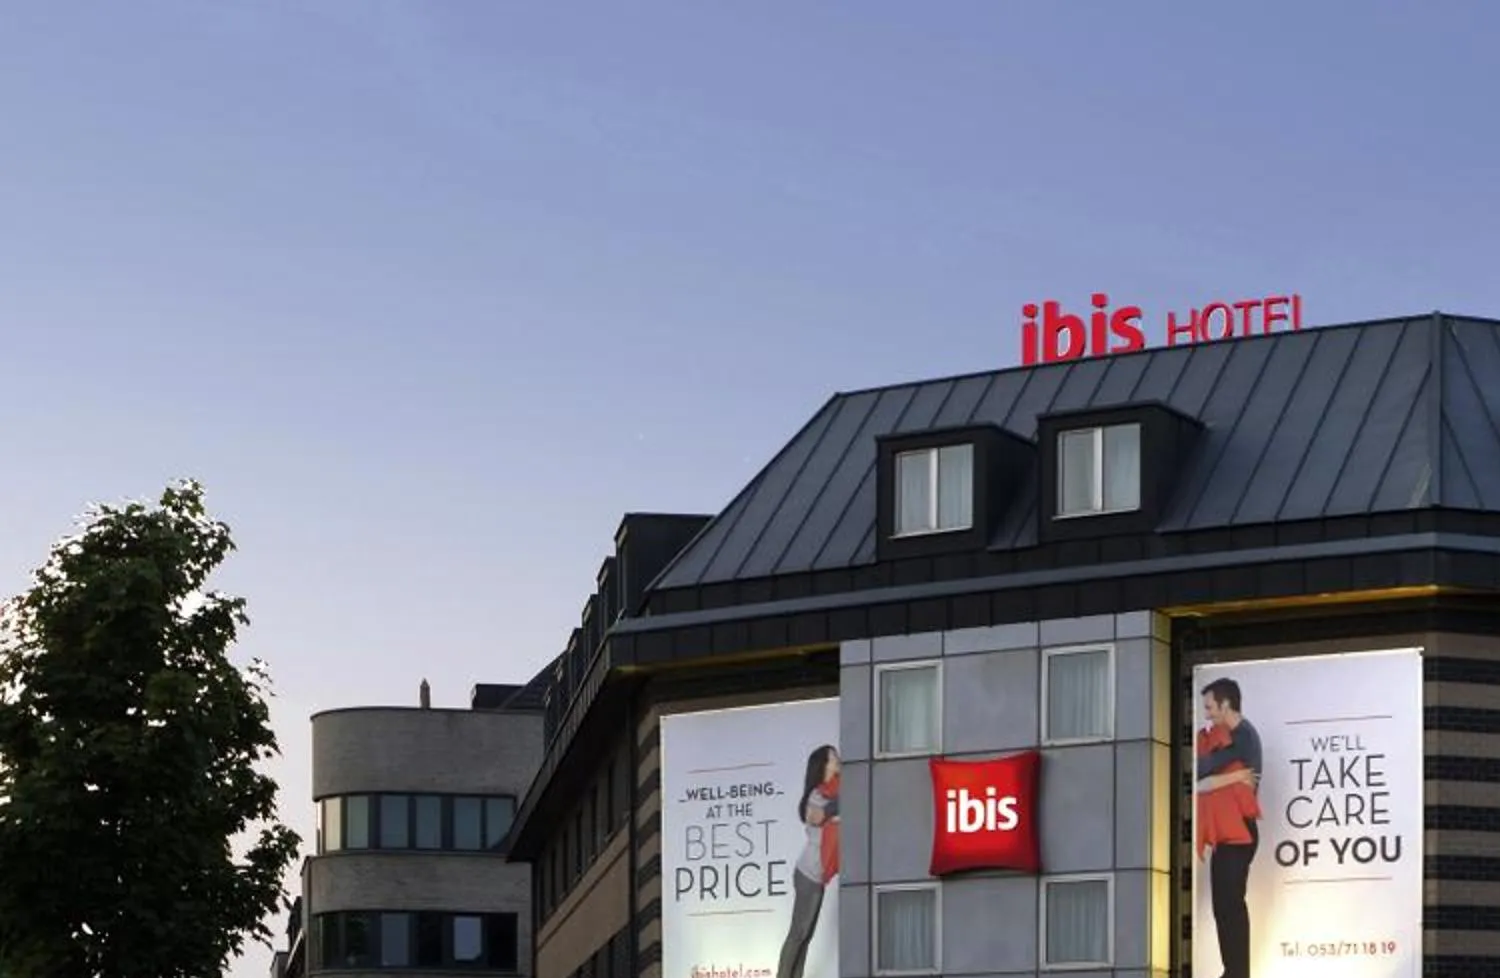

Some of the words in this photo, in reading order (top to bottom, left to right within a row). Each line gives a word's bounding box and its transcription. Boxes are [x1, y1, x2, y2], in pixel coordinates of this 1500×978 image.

[1021, 293, 1146, 366] ibis
[1167, 294, 1302, 348] HOTEL
[1311, 735, 1366, 752] WE'LL
[1290, 754, 1386, 791] TAKE
[706, 805, 723, 820] AT
[728, 803, 754, 818] THE
[946, 786, 1019, 833] ibis
[1285, 791, 1391, 829] CARE
[685, 820, 778, 862] BEST
[1275, 839, 1320, 867] OF
[1330, 835, 1402, 864] YOU
[675, 861, 788, 902] PRICE
